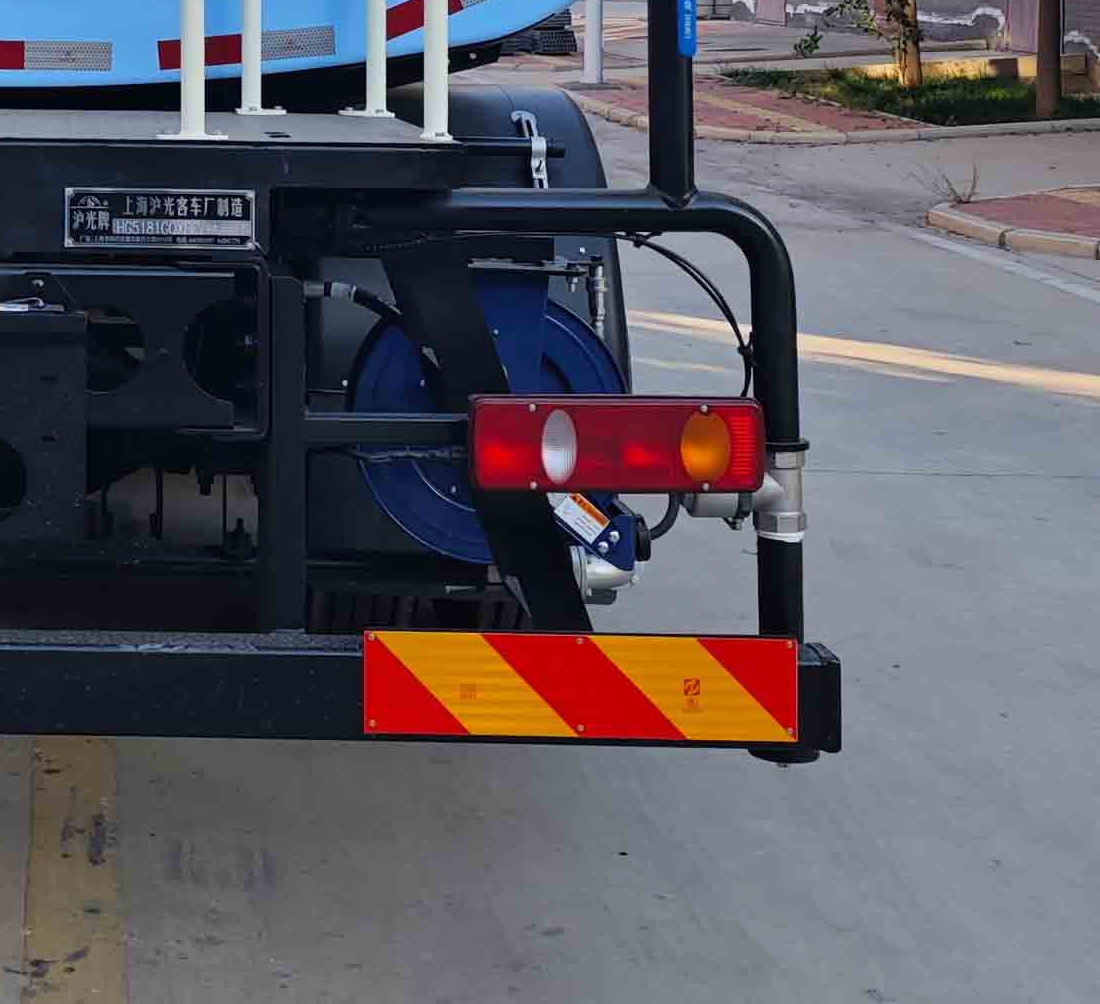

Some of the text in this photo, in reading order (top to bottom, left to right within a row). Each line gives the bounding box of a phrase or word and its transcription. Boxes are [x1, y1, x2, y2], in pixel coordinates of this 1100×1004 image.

[122, 196, 243, 217] 上海沪光客车厂制造
[73, 211, 110, 230] 沪光牌
